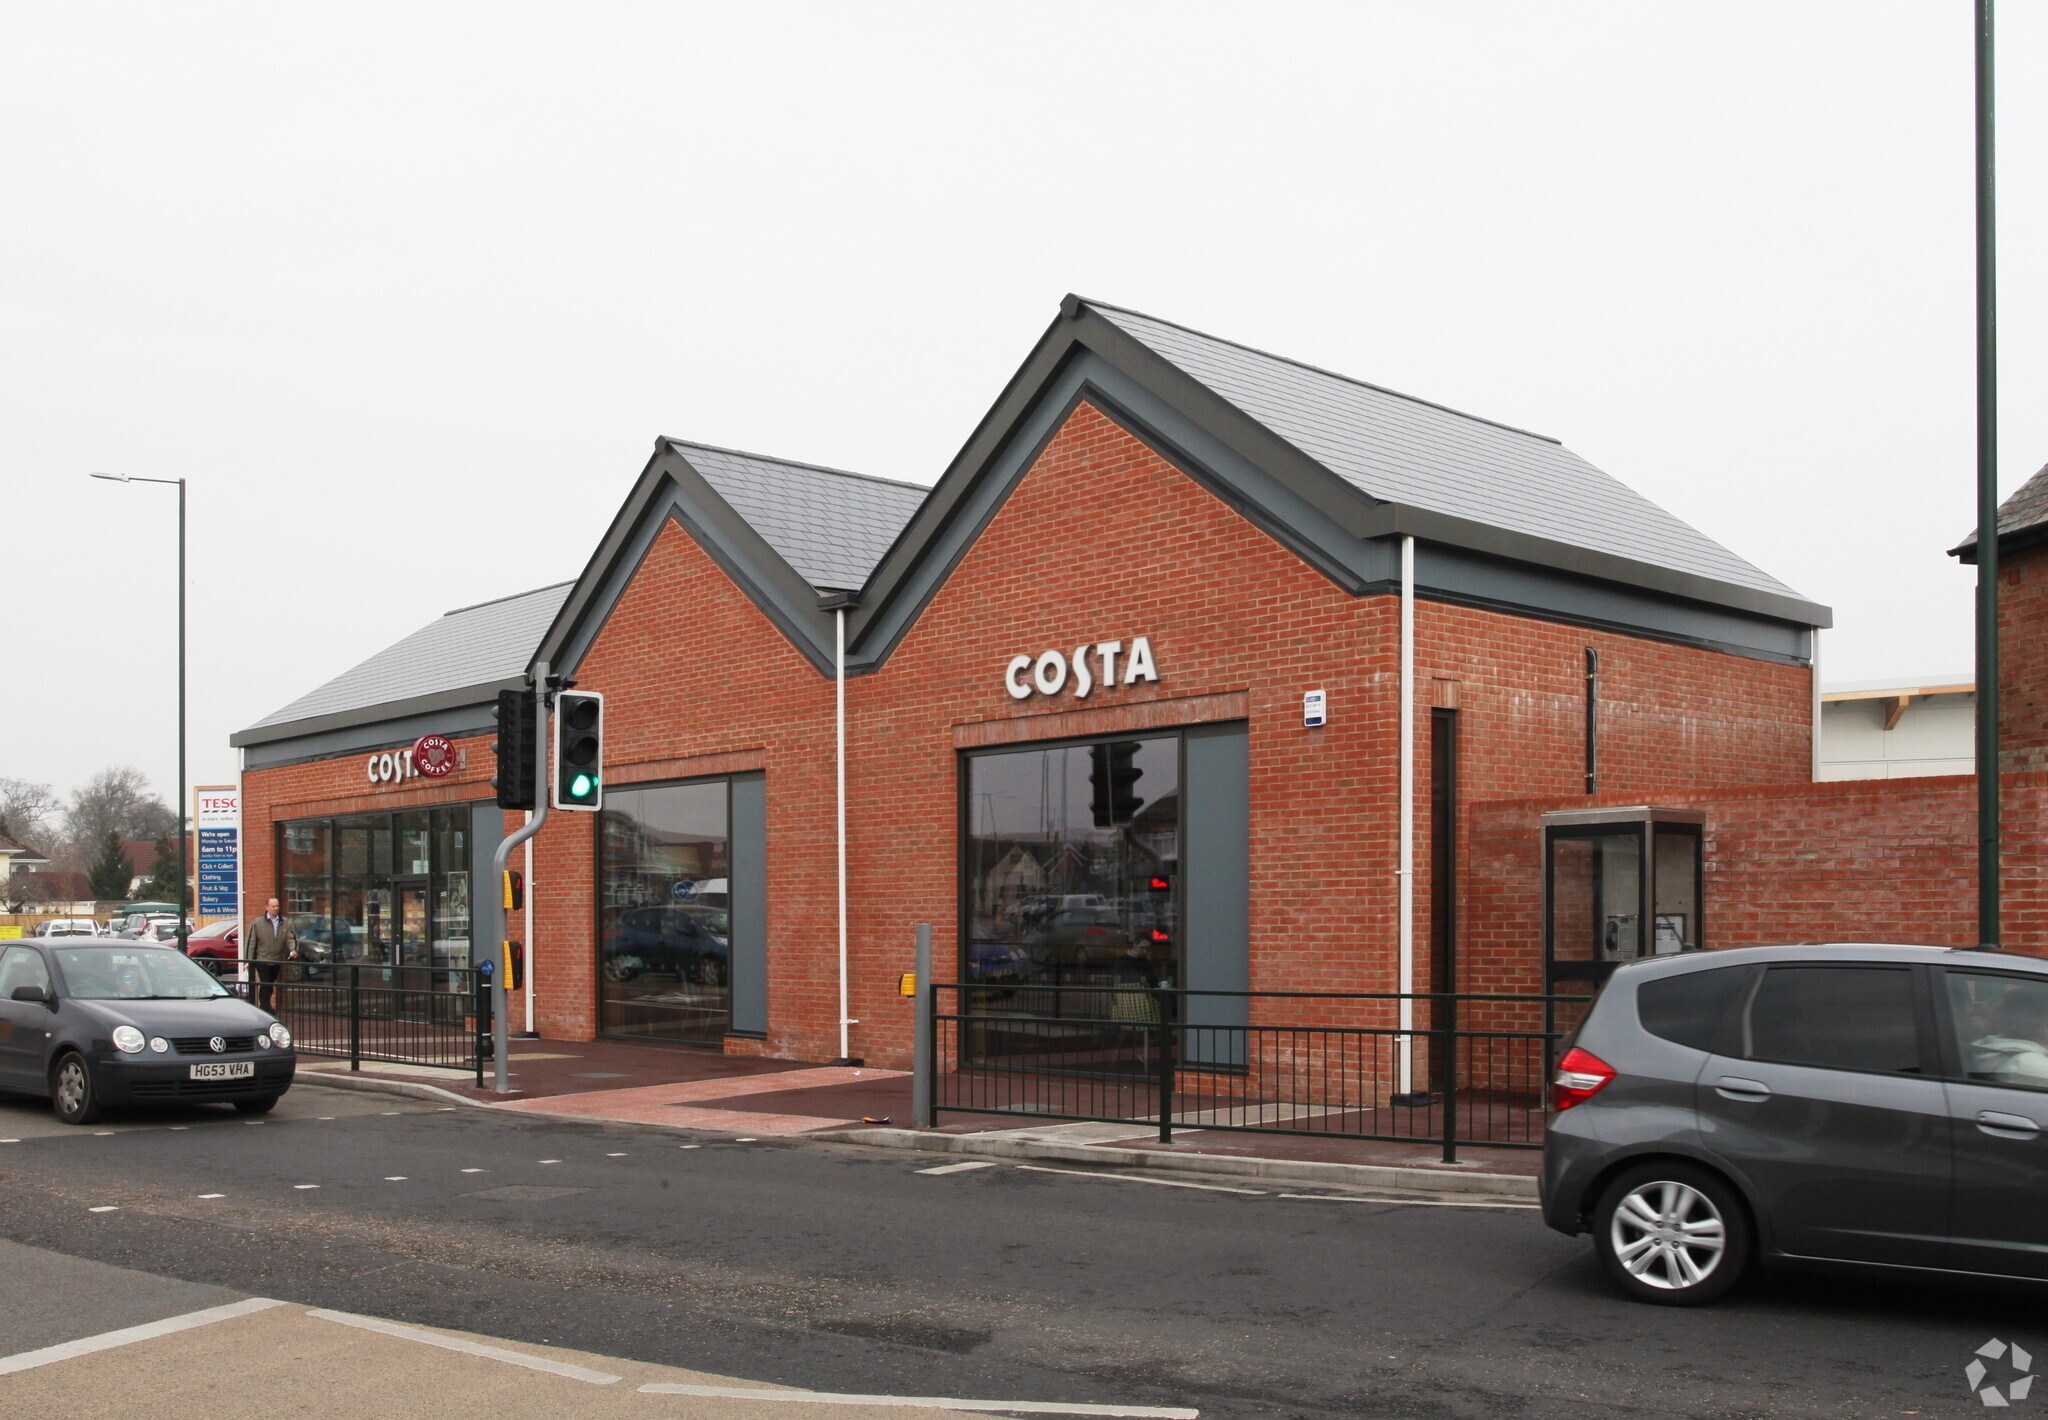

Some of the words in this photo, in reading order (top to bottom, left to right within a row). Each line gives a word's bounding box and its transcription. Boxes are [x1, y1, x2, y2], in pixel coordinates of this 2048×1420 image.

[1005, 636, 1161, 699] COSTA
[423, 739, 448, 750] COSTA
[368, 750, 418, 783] COST
[421, 759, 451, 773] COFFEE
[202, 798, 237, 808] TESC
[195, 1065, 226, 1077] HG53
[229, 1063, 250, 1075] VHA
